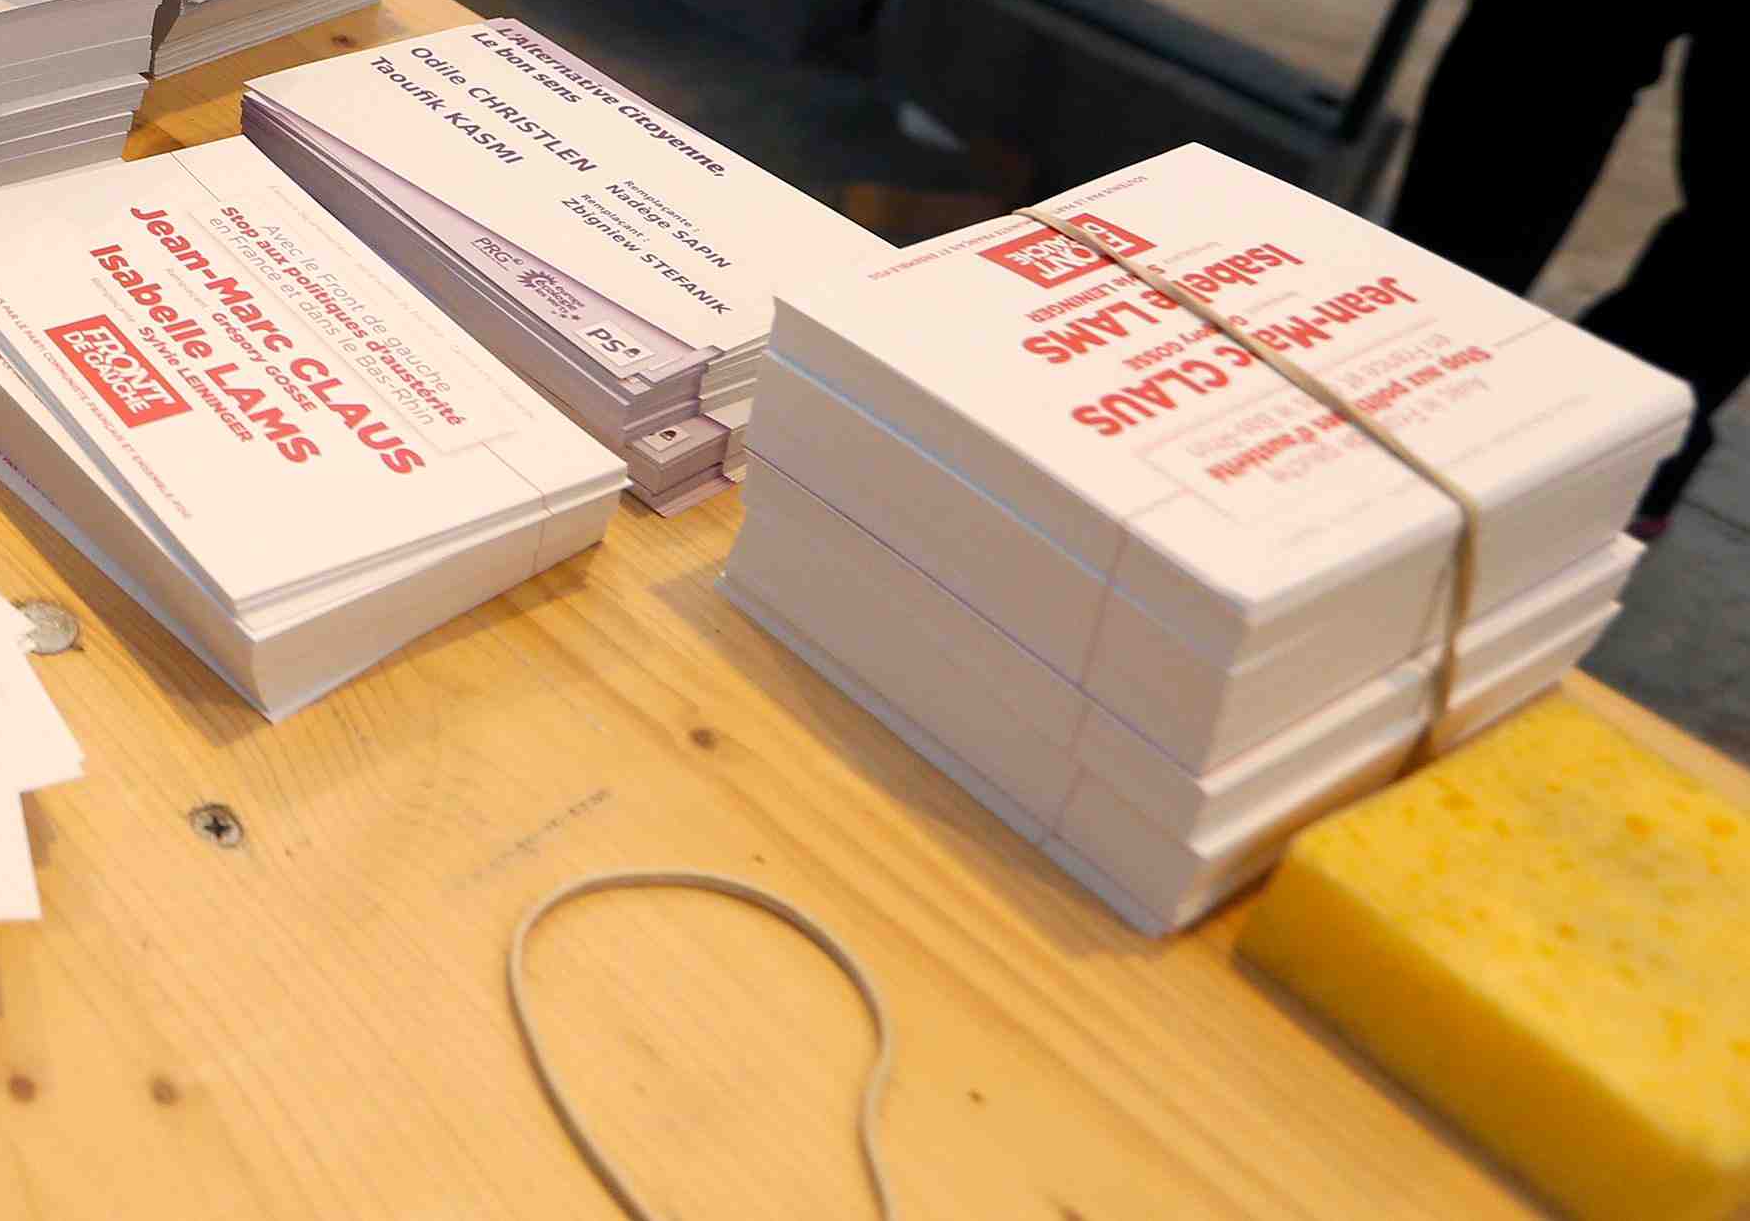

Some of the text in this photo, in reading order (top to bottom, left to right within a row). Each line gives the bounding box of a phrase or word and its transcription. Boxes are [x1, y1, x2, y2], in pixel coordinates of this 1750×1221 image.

[370, 56, 524, 164] Taoufik KASMI
[411, 47, 598, 172] Odile CHRISTLEN
[471, 32, 582, 103] Le bon sens
[497, 28, 726, 177] L'Alternative Citoyenne,
[474, 237, 513, 265] PRG
[561, 198, 640, 252] Zbigniew
[640, 253, 732, 315] STEFANIK
[605, 184, 731, 268] Nadège SAPIN
[1032, 230, 1137, 280] FONT
[90, 244, 213, 359] Isabelle
[204, 363, 321, 463] LAMS
[131, 208, 293, 352] Jean-Marc
[290, 357, 426, 474] CLAUS
[209, 217, 435, 426] en France et dans le Bas-Rhin
[220, 206, 259, 239] Stop
[256, 239, 290, 266] aux
[282, 266, 368, 339] politiques
[365, 340, 466, 426] d'austérité
[263, 223, 304, 259] Avec
[301, 257, 320, 273] le
[317, 272, 365, 313] Front
[362, 313, 387, 334] de
[384, 336, 452, 393] gauche
[586, 328, 626, 354] PS
[1023, 243, 1305, 363] Isabele LAMS
[1026, 283, 1118, 323] LEININGER
[1072, 277, 1418, 437] Jean-Mac CLAUS
[1122, 342, 1185, 371] GOSSE
[63, 330, 90, 354] DE
[83, 351, 150, 414] GAUCHE
[82, 326, 176, 405] FRONT
[139, 326, 181, 366] Sylvie
[178, 367, 255, 442] LEININGER
[212, 312, 318, 412] Grégory GOSSE
